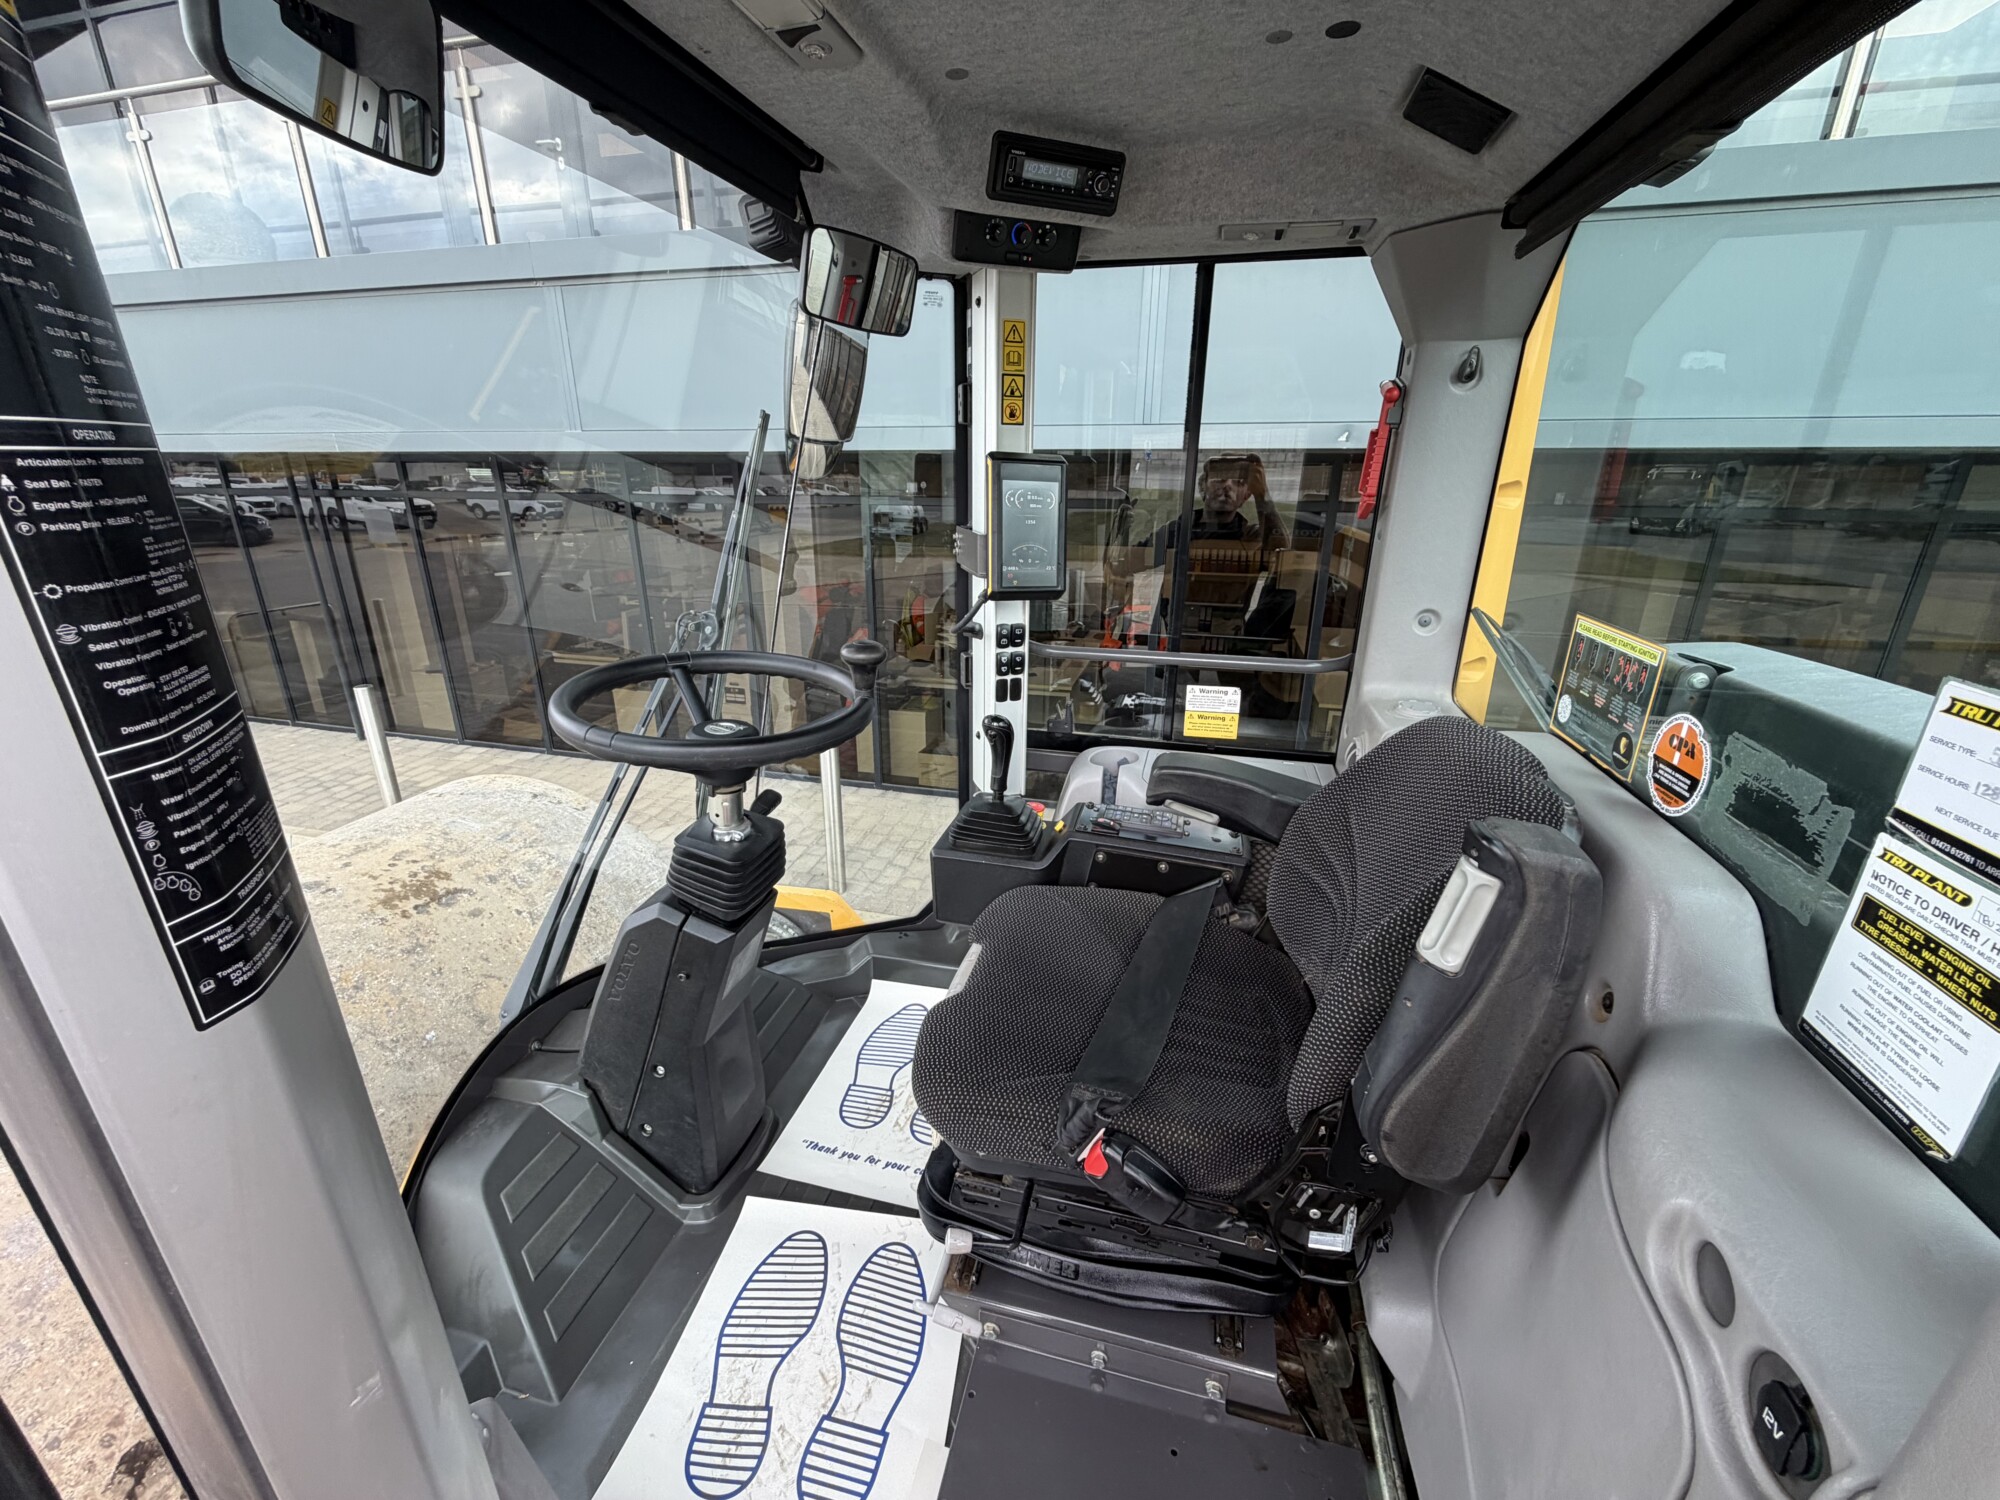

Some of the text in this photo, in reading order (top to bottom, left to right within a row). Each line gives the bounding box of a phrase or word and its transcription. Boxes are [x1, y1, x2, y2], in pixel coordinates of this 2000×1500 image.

[72, 429, 116, 441] OPERATING
[16, 458, 72, 467] Articulation
[24, 478, 103, 489] Seat Belt FASTEN
[32, 501, 70, 511] Engine
[40, 522, 81, 532] Parking
[82, 520, 102, 530] Brake
[64, 581, 115, 594] Propulsion
[80, 620, 122, 633] Vibration
[88, 640, 119, 652] Select
[1579, 624, 1658, 661] PLEASE READ BEFORE STARTING IGNITION
[95, 656, 137, 671] Vibration
[103, 675, 148, 690] Operation:
[159, 665, 189, 684] STAY SEATED
[117, 681, 156, 697] Operating
[163, 680, 179, 692] ALLOW
[166, 688, 182, 701] ALLOW
[1199, 688, 1229, 696] Warning
[1197, 714, 1226, 722] Warning
[1950, 701, 1995, 723] TRU
[120, 718, 158, 735] Downhill
[182, 719, 214, 743] SHUTDOWN
[1669, 733, 1696, 760] CPA
[1929, 735, 1958, 751] SERVICE
[1957, 745, 1977, 758] TYPE:
[151, 765, 184, 782] Machine
[1917, 764, 1970, 791] SERVICE HOURS:
[161, 793, 185, 807] Water
[167, 805, 199, 823] Vibration
[1935, 806, 2000, 840] NEXT SERVICE DUE
[173, 823, 201, 839] Parking
[179, 838, 205, 855] Engine
[1915, 829, 1931, 843] CALL
[1930, 837, 1951, 852] 01473
[1950, 848, 1976, 865] 612761
[1975, 860, 1985, 870] TO
[185, 853, 213, 871] Ignition
[237, 868, 266, 900] TRANSPORT
[1882, 851, 1968, 904] TRU PLANT
[1871, 870, 1912, 900] NOTICE
[1913, 894, 1930, 911] TO
[1931, 906, 1981, 942] DRIVER
[1867, 881, 1997, 965] LISTED BELOW ARE DAILY CHECKS THAT MUST
[203, 924, 234, 944] Hauling:
[219, 934, 246, 952] Machine
[1876, 920, 1983, 998] GREASE WATER LEVEL
[1878, 908, 1993, 990] FUEL LEVEL ENGINE OIL
[216, 960, 246, 979] Towing:
[230, 968, 243, 981] DO
[607, 939, 640, 1000] VOLVO
[1860, 919, 1998, 1022] TYRE PRESSURE WHEEL NUTS
[1857, 951, 1973, 1041] CONTAMINATED FUEL CAUSES DOWNTIME
[1870, 950, 1963, 1022] RUNNING OUT OF FUEL OR USING
[1849, 961, 1969, 1056] RUNNING OUT OF WATER COOLANT CAUSES
[1867, 984, 1939, 1044] THE ENGINE TO OVERHEAT
[1851, 988, 1944, 1067] RUNNING OUT OF ENGINE OIL WILL
[1864, 1009, 1922, 1059] DAMAGE THE ENGINE
[1840, 1003, 1941, 1093] RUNNING WITH FLAT TYRES OR LOOSE
[1847, 1020, 1865, 1039] WHEEL
[1865, 1036, 1880, 1052] NUTS
[1886, 1055, 1923, 1089] DANGEROUS
[838, 1150, 861, 1161] you
[864, 1155, 882, 1166] for
[882, 1161, 910, 1173] your
[1762, 1406, 1784, 1439] 12V
